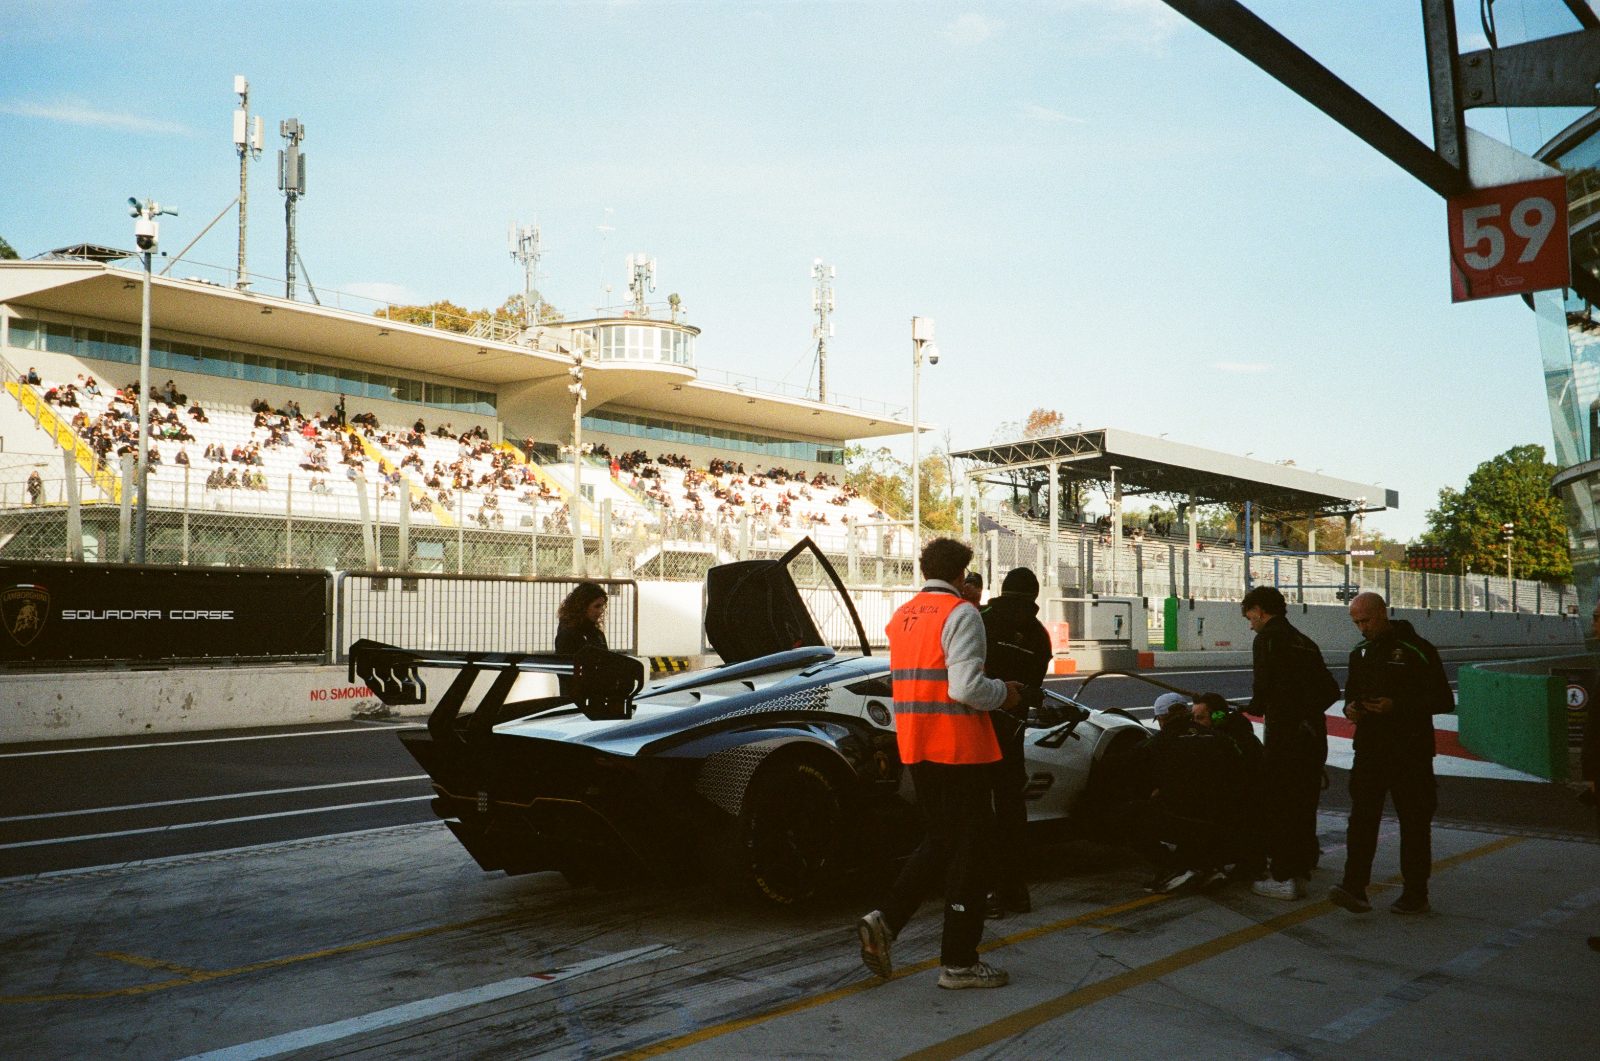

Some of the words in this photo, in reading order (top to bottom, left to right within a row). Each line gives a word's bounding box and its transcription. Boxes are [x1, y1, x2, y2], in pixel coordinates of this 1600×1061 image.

[1461, 197, 1557, 271] 59
[62, 609, 161, 620] SQUADRA
[169, 609, 233, 620] CORSE
[903, 616, 918, 631] 17
[310, 690, 327, 701] NO
